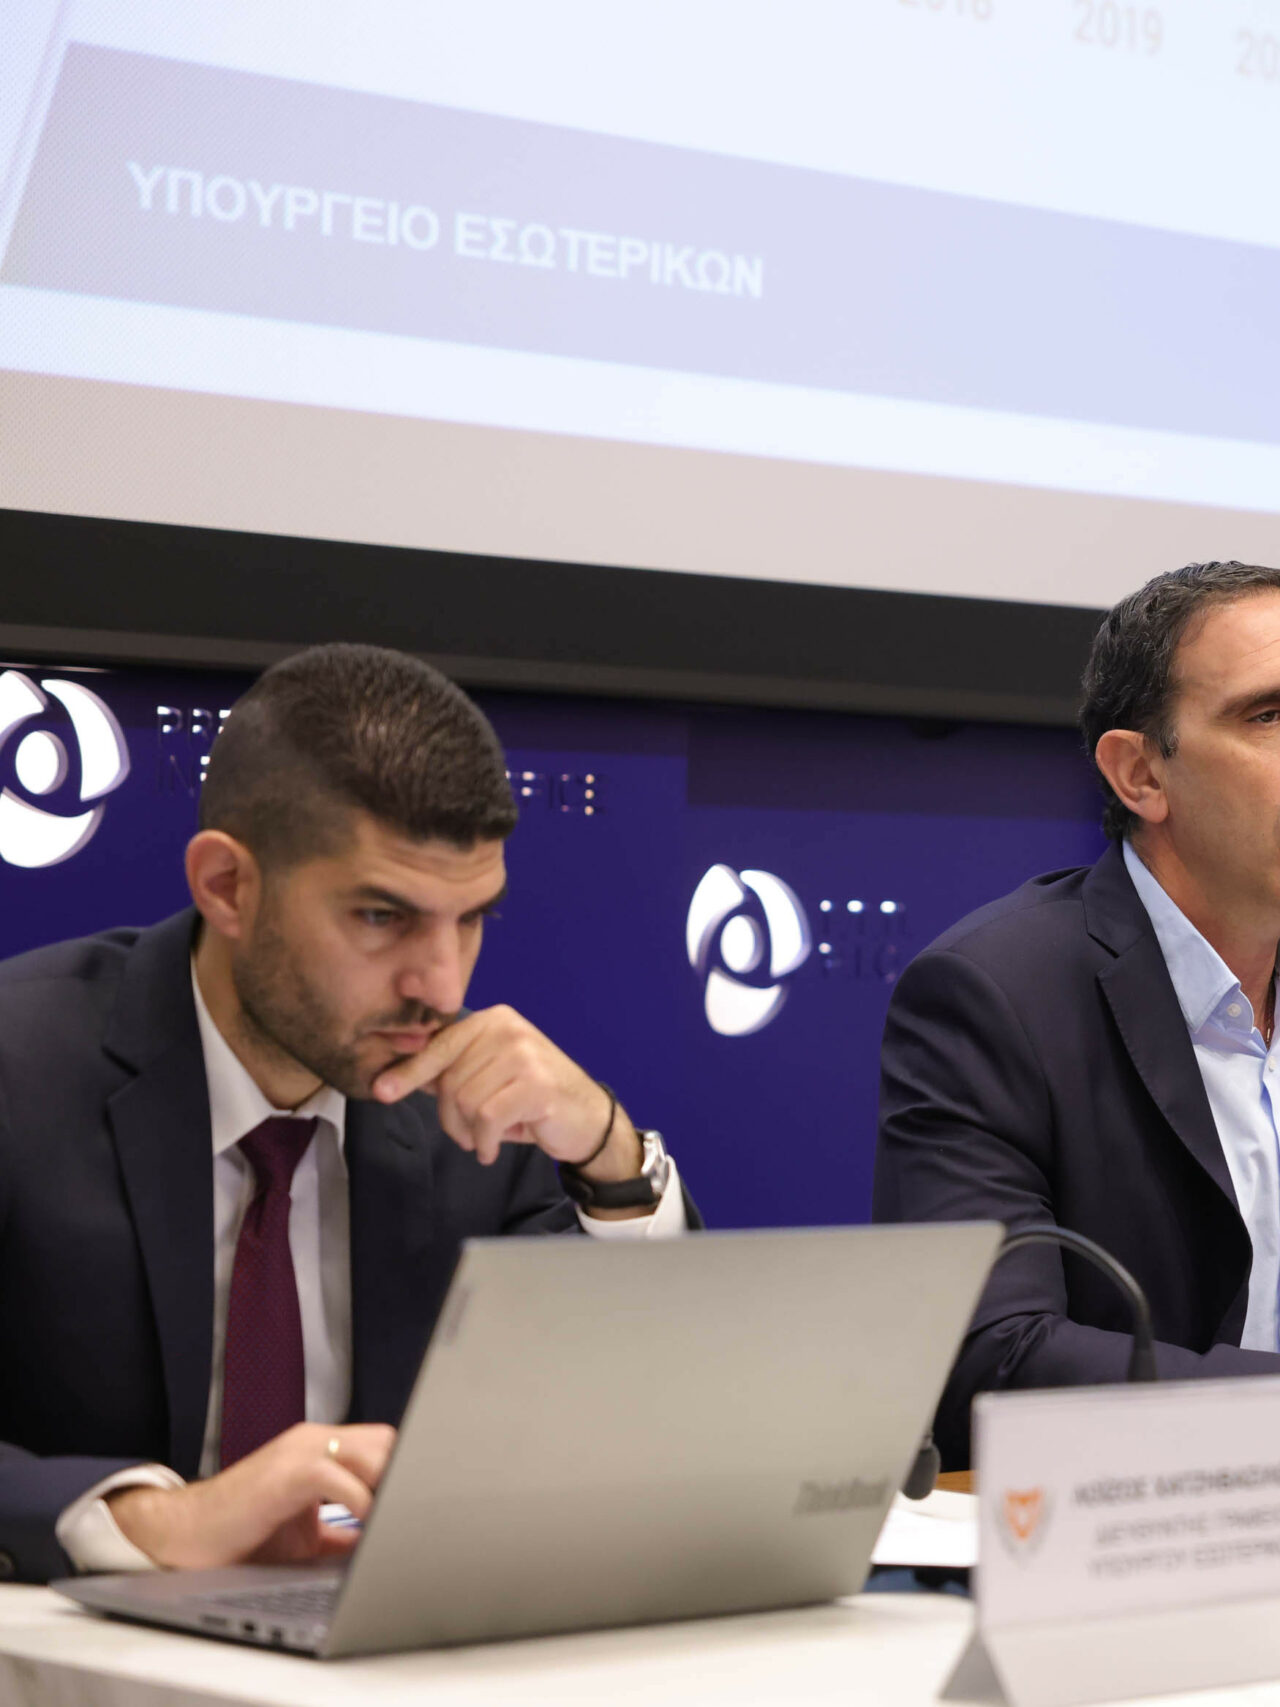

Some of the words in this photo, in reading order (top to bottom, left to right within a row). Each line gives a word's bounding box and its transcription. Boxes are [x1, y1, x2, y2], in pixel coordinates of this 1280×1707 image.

[1073, 0, 1163, 56] 2019
[126, 159, 441, 252] ΥΠΟΥΡΓΕΙΟ
[453, 211, 764, 300] ΕΣΩΤΕΡΙΚΩΝ
